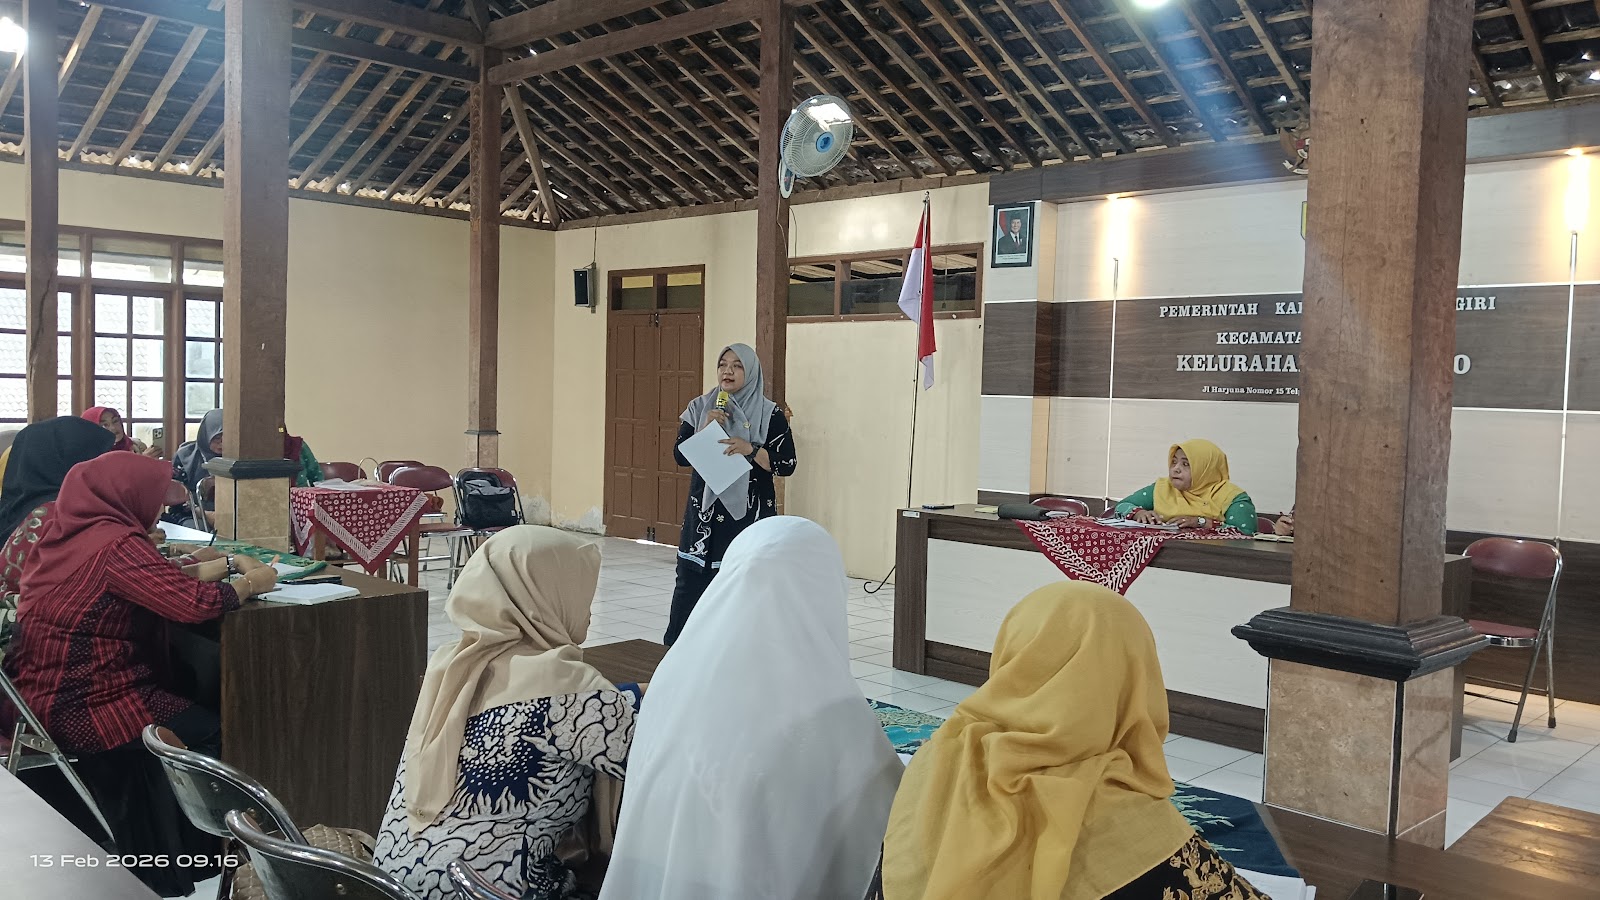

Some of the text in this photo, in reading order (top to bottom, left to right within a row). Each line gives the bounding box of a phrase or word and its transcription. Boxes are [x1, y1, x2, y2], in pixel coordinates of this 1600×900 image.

[1159, 302, 1258, 318] PEMERINTAH
[1176, 354, 1301, 373] KELURAHA
[1202, 385, 1210, 393] Jl
[1246, 386, 1274, 395] Nomor
[1275, 387, 1284, 395] 15
[1285, 387, 1300, 396] Tel
